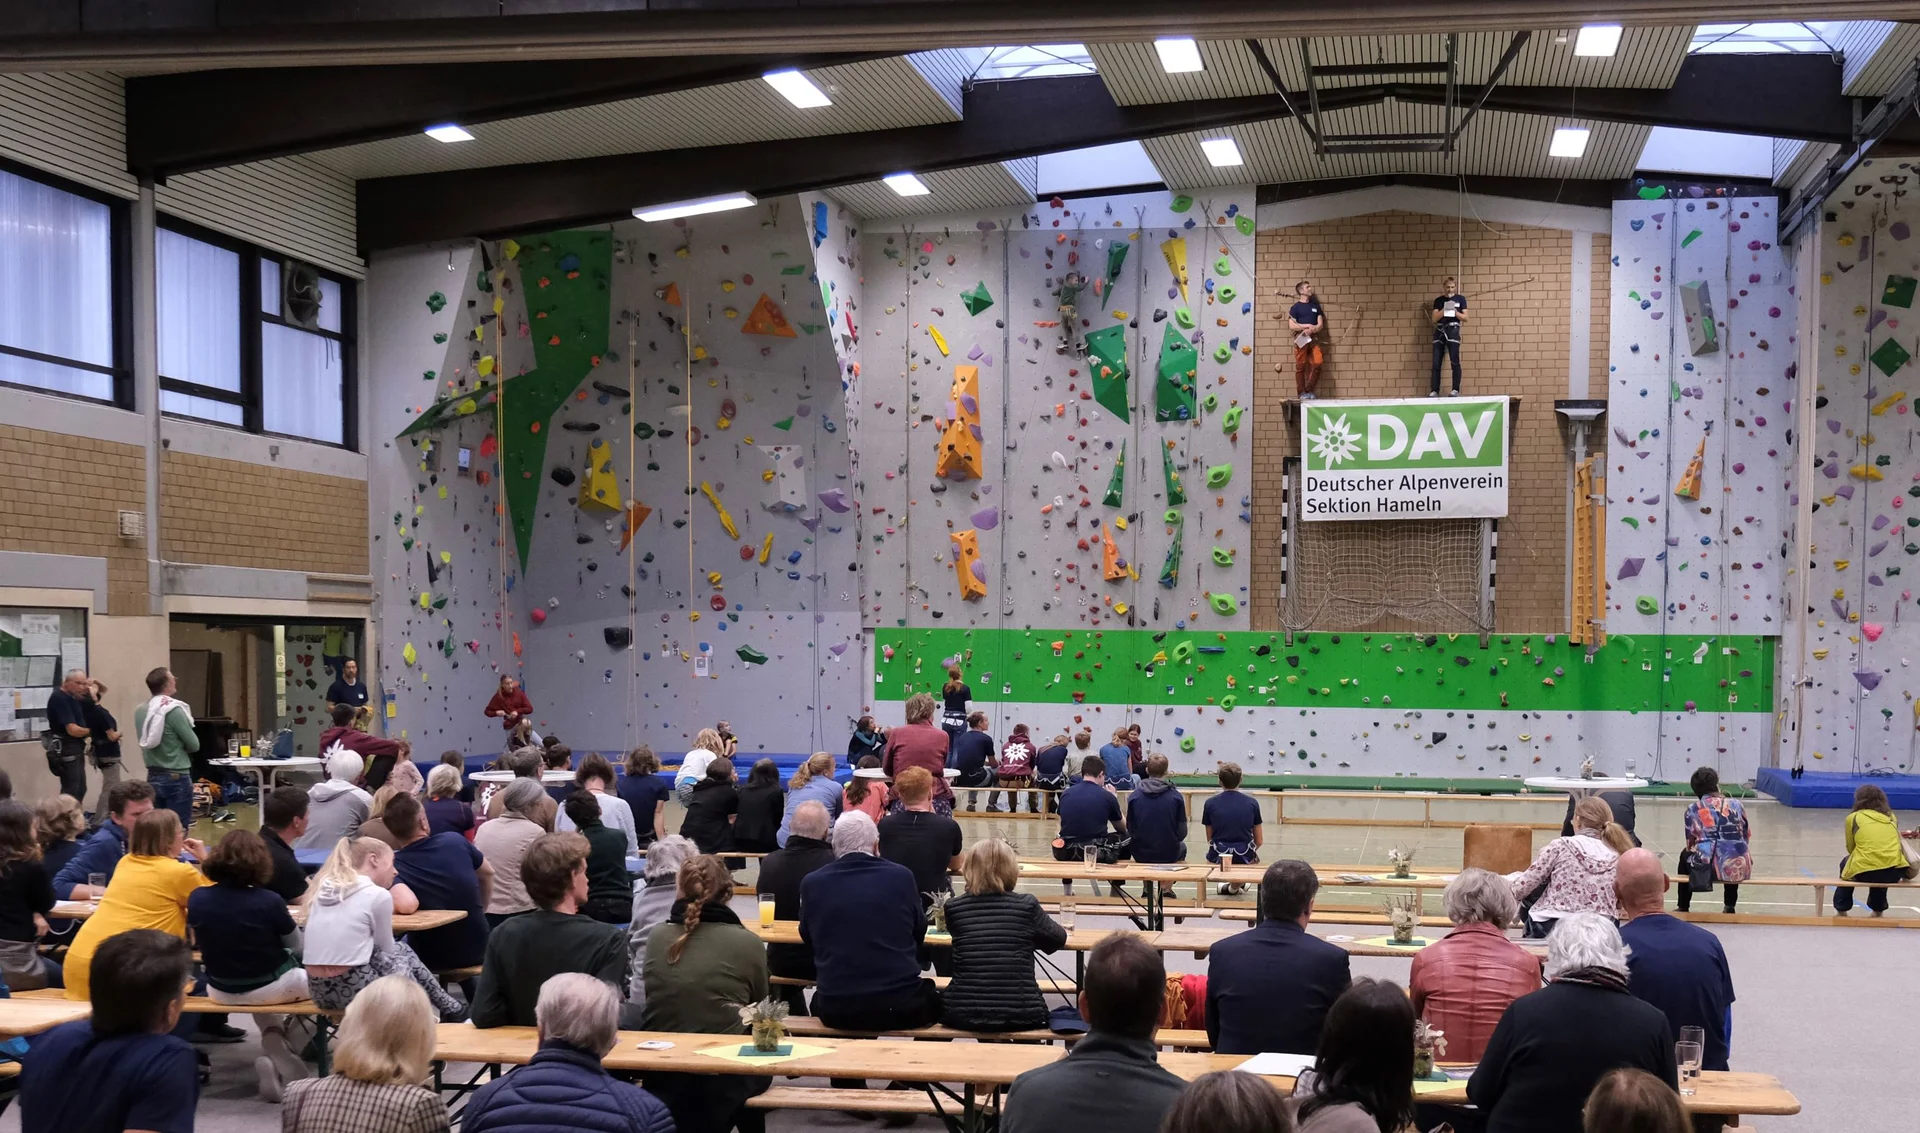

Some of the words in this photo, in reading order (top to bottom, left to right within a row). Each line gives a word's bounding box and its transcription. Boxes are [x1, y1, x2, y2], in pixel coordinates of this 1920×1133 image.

[1367, 410, 1496, 461] DAV
[1307, 475, 1394, 492] Deutscher
[1399, 472, 1503, 494] Alpenverein
[1306, 497, 1371, 514] Sektion
[1377, 496, 1441, 513] Hameln
